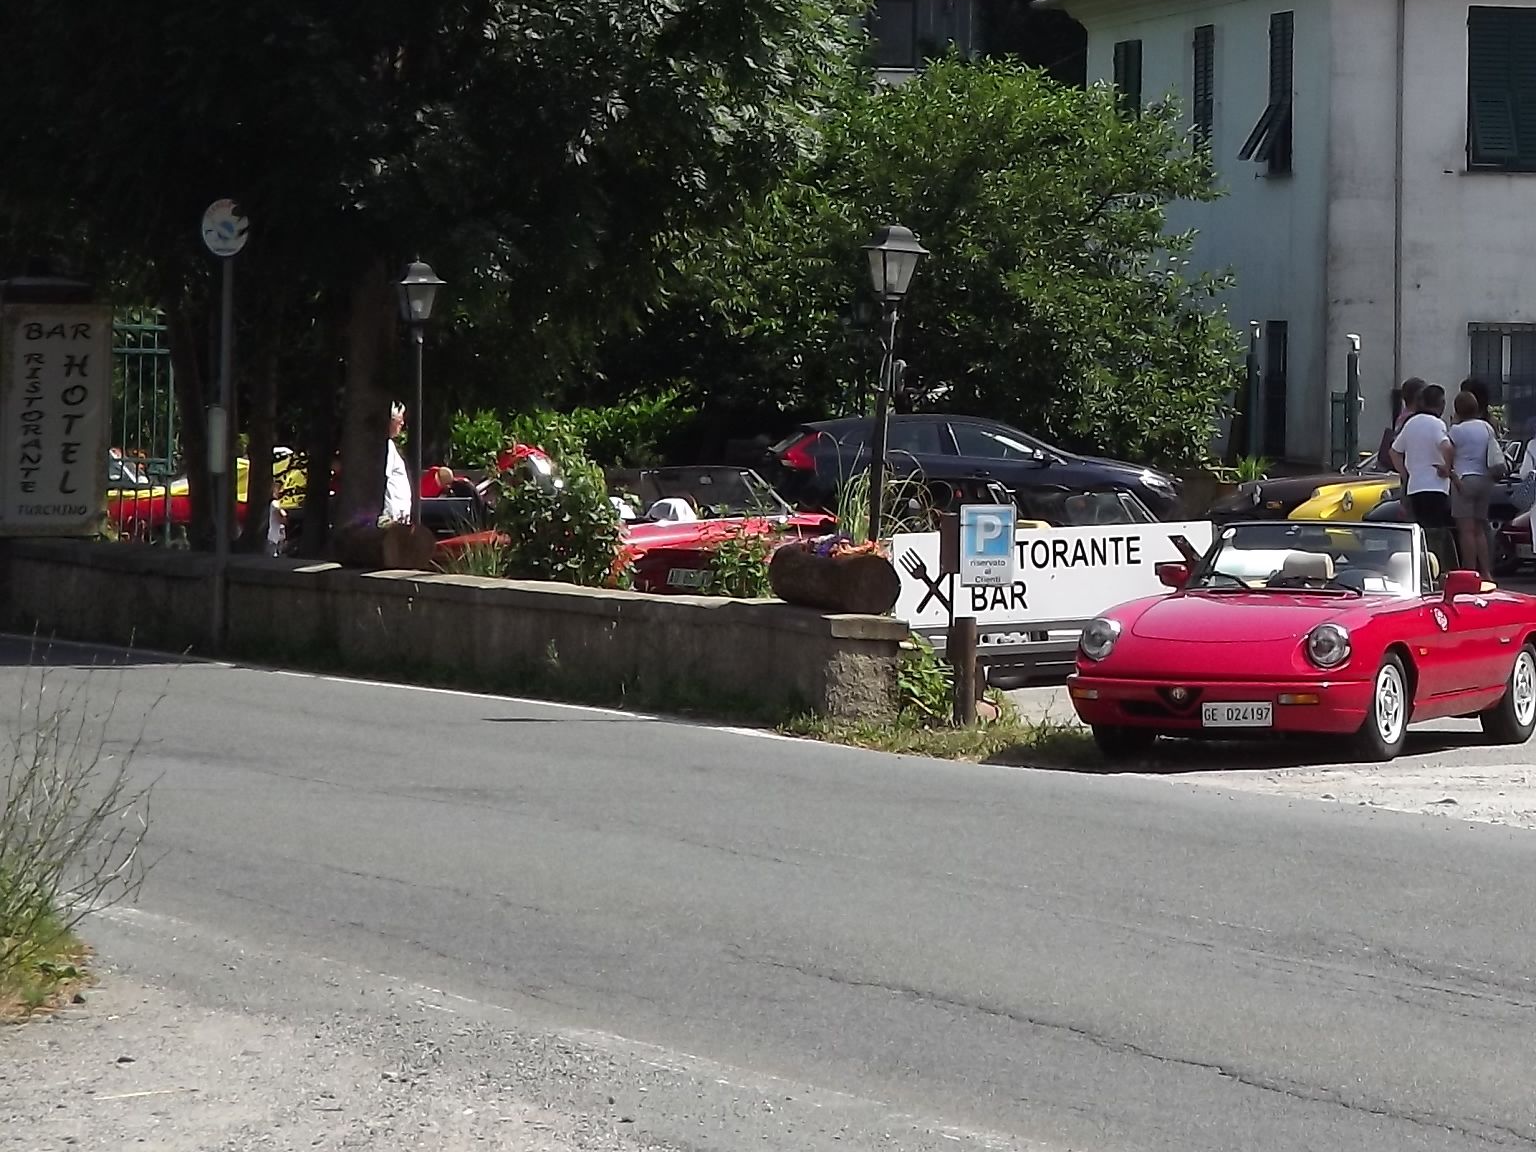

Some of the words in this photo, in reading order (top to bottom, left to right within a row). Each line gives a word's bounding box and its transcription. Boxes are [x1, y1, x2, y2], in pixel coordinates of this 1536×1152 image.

[23, 322, 92, 341] BAR
[19, 352, 45, 494] RISTORANTE
[59, 353, 91, 495] HOTEL
[17, 504, 88, 517] TURCHINO
[976, 514, 1002, 554] P
[969, 559, 1006, 567] riservato
[1015, 535, 1142, 570] TORANTE
[974, 575, 1001, 584] Clienti
[971, 580, 1029, 612] BAR
[1203, 708, 1218, 721] GE
